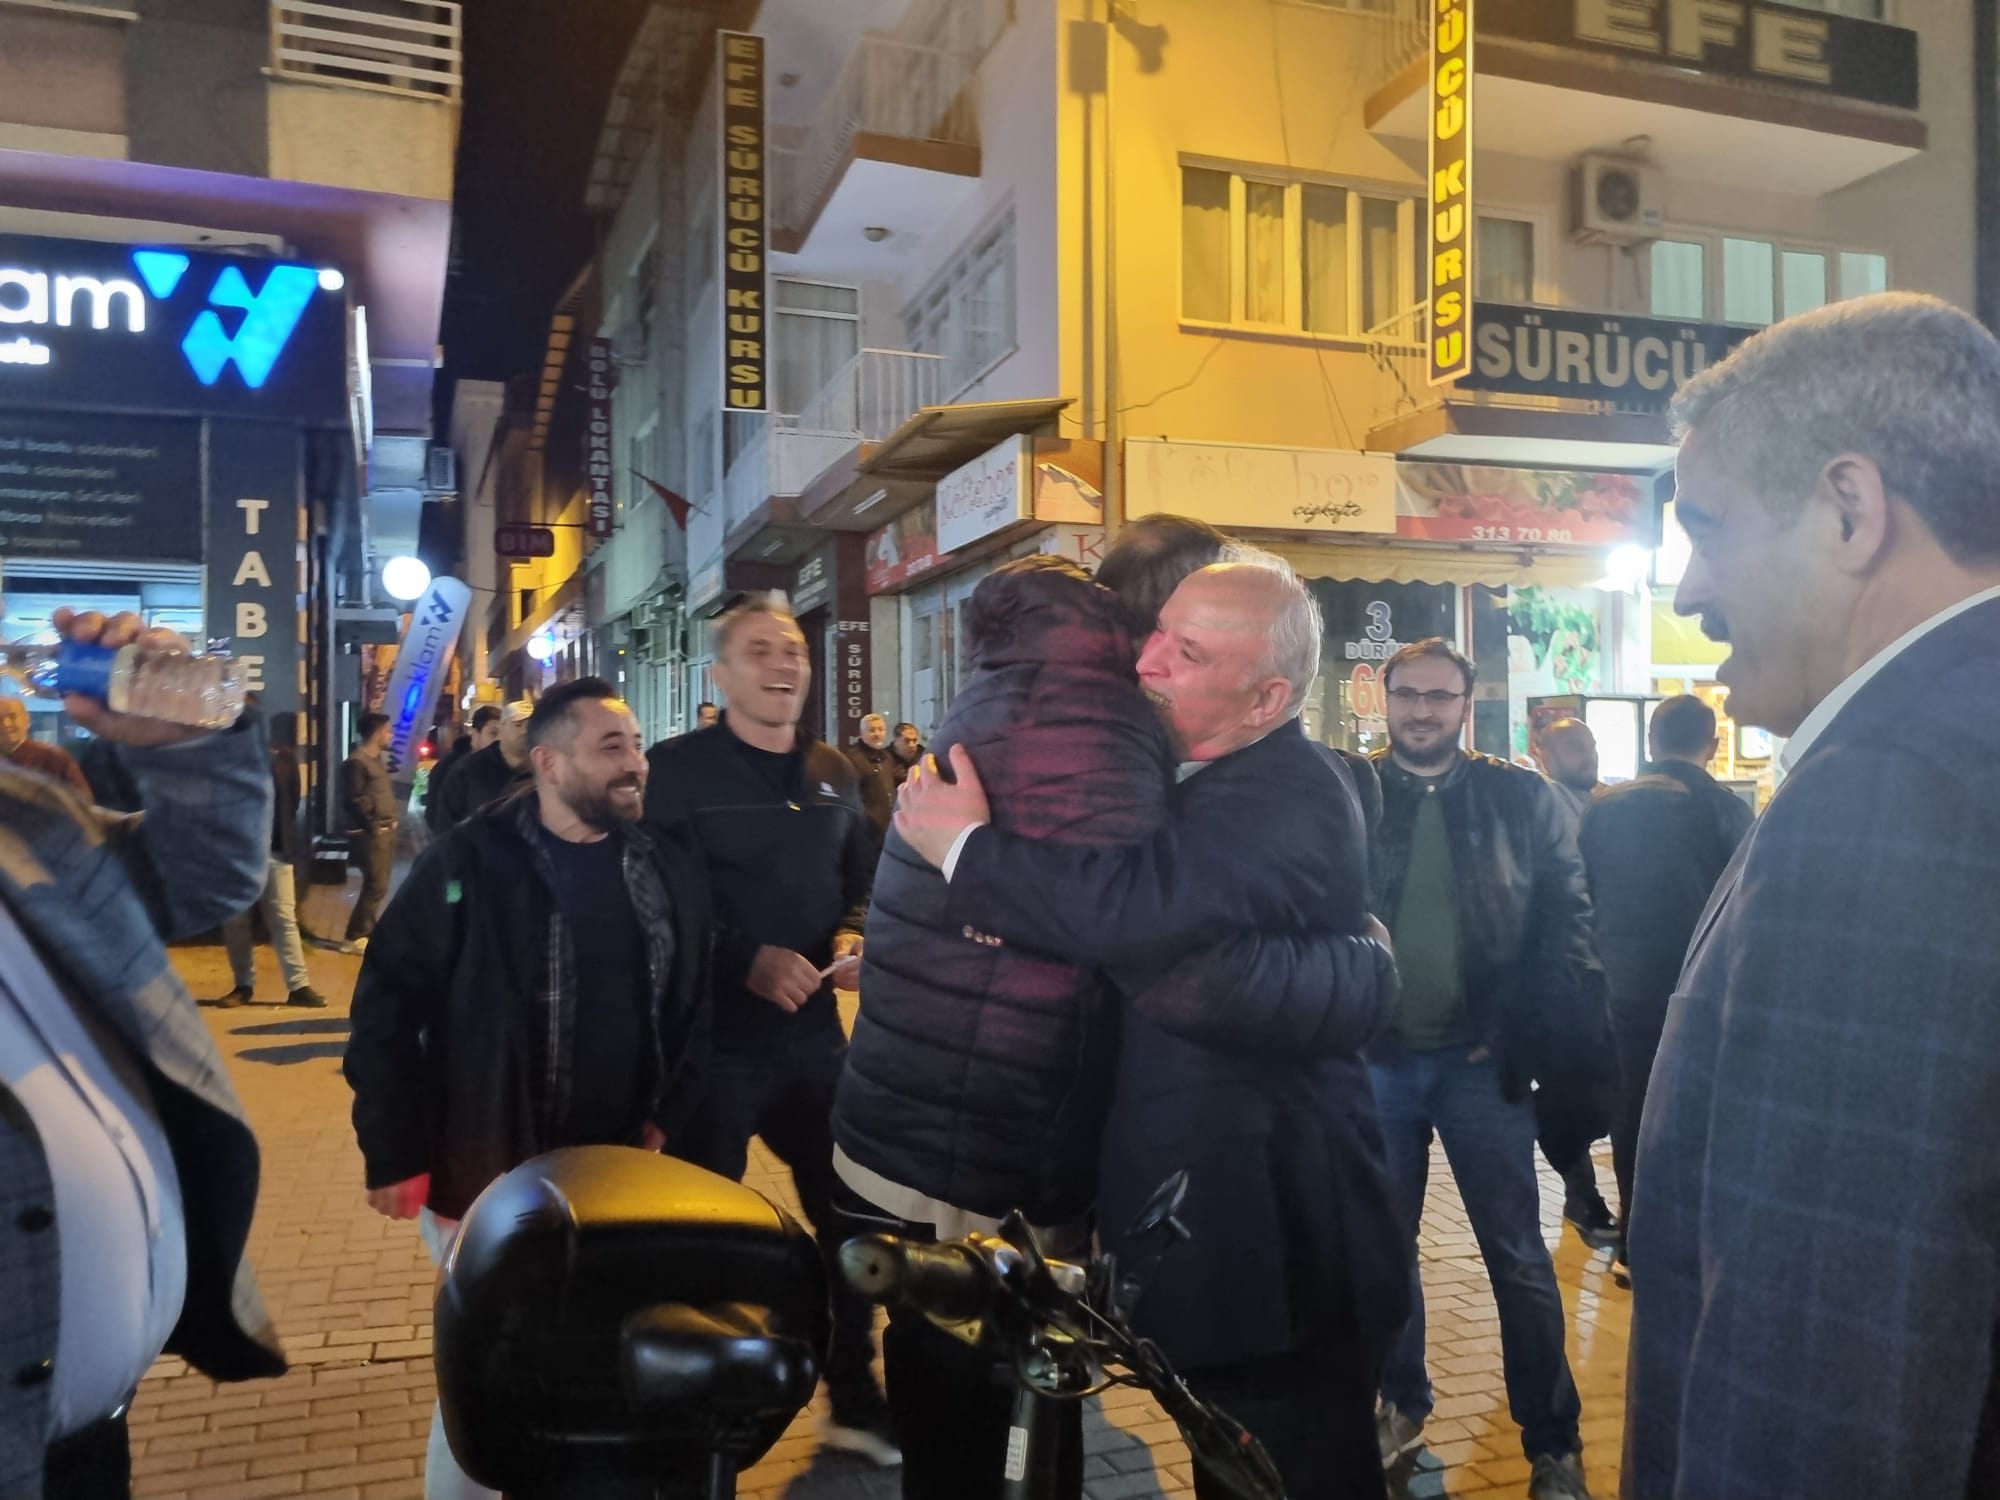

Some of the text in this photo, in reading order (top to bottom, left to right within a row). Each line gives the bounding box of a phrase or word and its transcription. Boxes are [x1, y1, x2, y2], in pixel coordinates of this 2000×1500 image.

[1573, 0, 1832, 85] EFE
[726, 38, 761, 408] EFE SÜRÜCÜ KURSU
[1434, 159, 1465, 369] KURSU
[1475, 314, 1706, 391] SÜRÜCÜ
[1471, 525, 1573, 542] 313 70 80
[838, 620, 870, 632] EFE
[1344, 638, 1412, 660] DÜRÜ
[1365, 600, 1393, 642] 3
